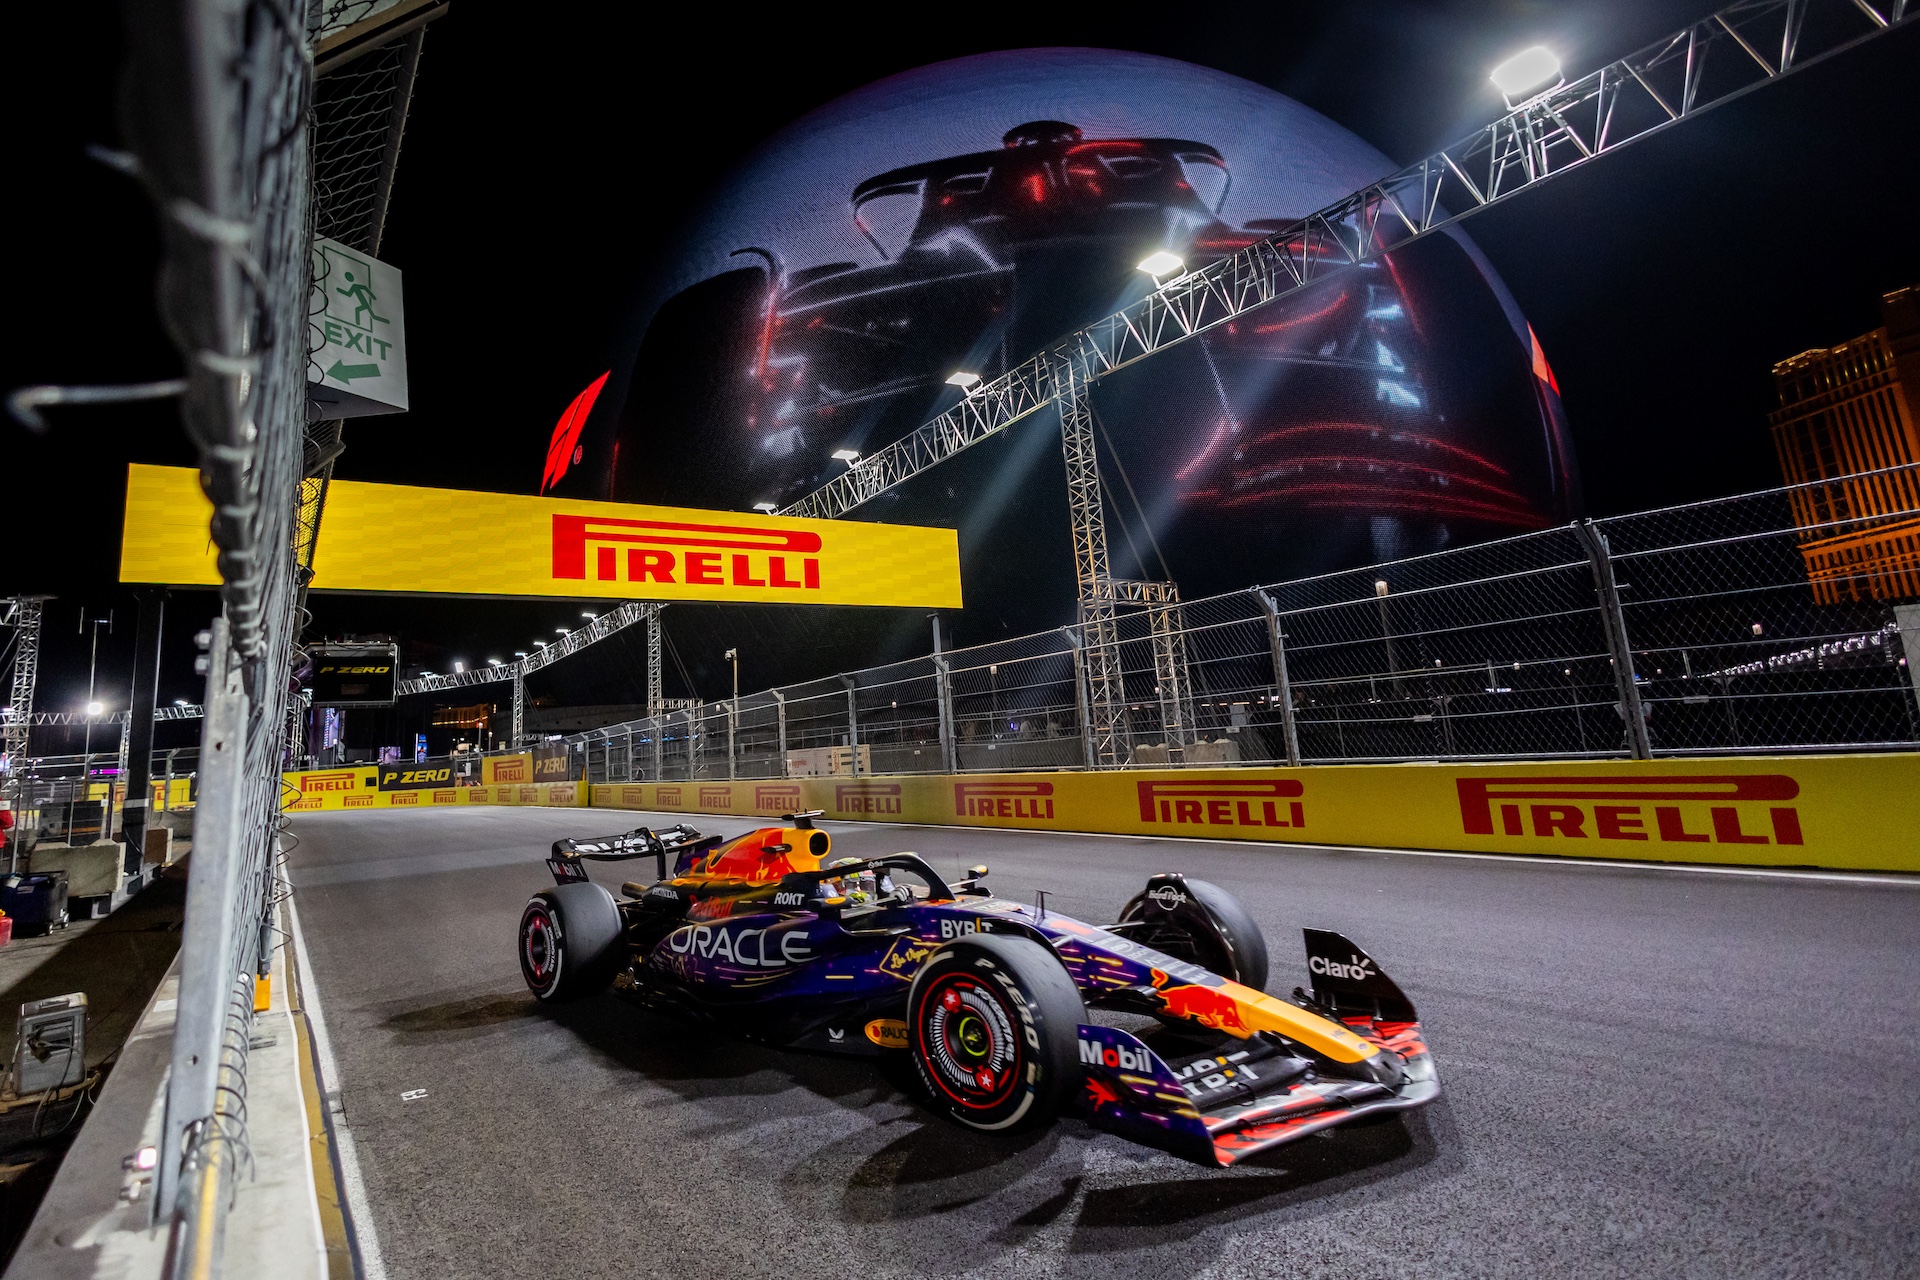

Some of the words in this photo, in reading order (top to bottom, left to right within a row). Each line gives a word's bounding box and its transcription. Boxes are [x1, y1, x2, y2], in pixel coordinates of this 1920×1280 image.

[325, 321, 392, 361] EXIT
[552, 514, 822, 589] PIRELLI
[383, 772, 398, 785] P
[400, 768, 451, 783] ZERO
[493, 759, 524, 782] PIRELLI
[535, 761, 542, 775] P
[544, 757, 567, 774] ZERO
[301, 773, 355, 792] PIRELLI
[289, 797, 322, 810] PIRELLI
[343, 795, 374, 807] PIRELLI
[391, 793, 418, 805] PIRELLI
[433, 790, 456, 803] PIRELLI
[656, 787, 682, 806] PIRELLI
[699, 787, 731, 808] PIRELLI
[755, 786, 801, 812] PIRELLI
[836, 785, 902, 814] PIRELLI
[955, 782, 1055, 819] PIRELLI
[1137, 780, 1305, 828] PIRELLI
[1456, 774, 1804, 846] PIRELLI
[552, 860, 575, 877] Mobil
[652, 887, 680, 900] HONDA
[774, 892, 805, 905] ROKT
[940, 917, 993, 938] BYBIT
[669, 924, 814, 967] ORACLE
[890, 952, 912, 970] Las
[904, 948, 930, 964] Vegas
[1309, 955, 1376, 981] Claro
[974, 957, 996, 969] P
[991, 970, 1041, 1051] ZERO
[1078, 1039, 1153, 1073] Mobil
